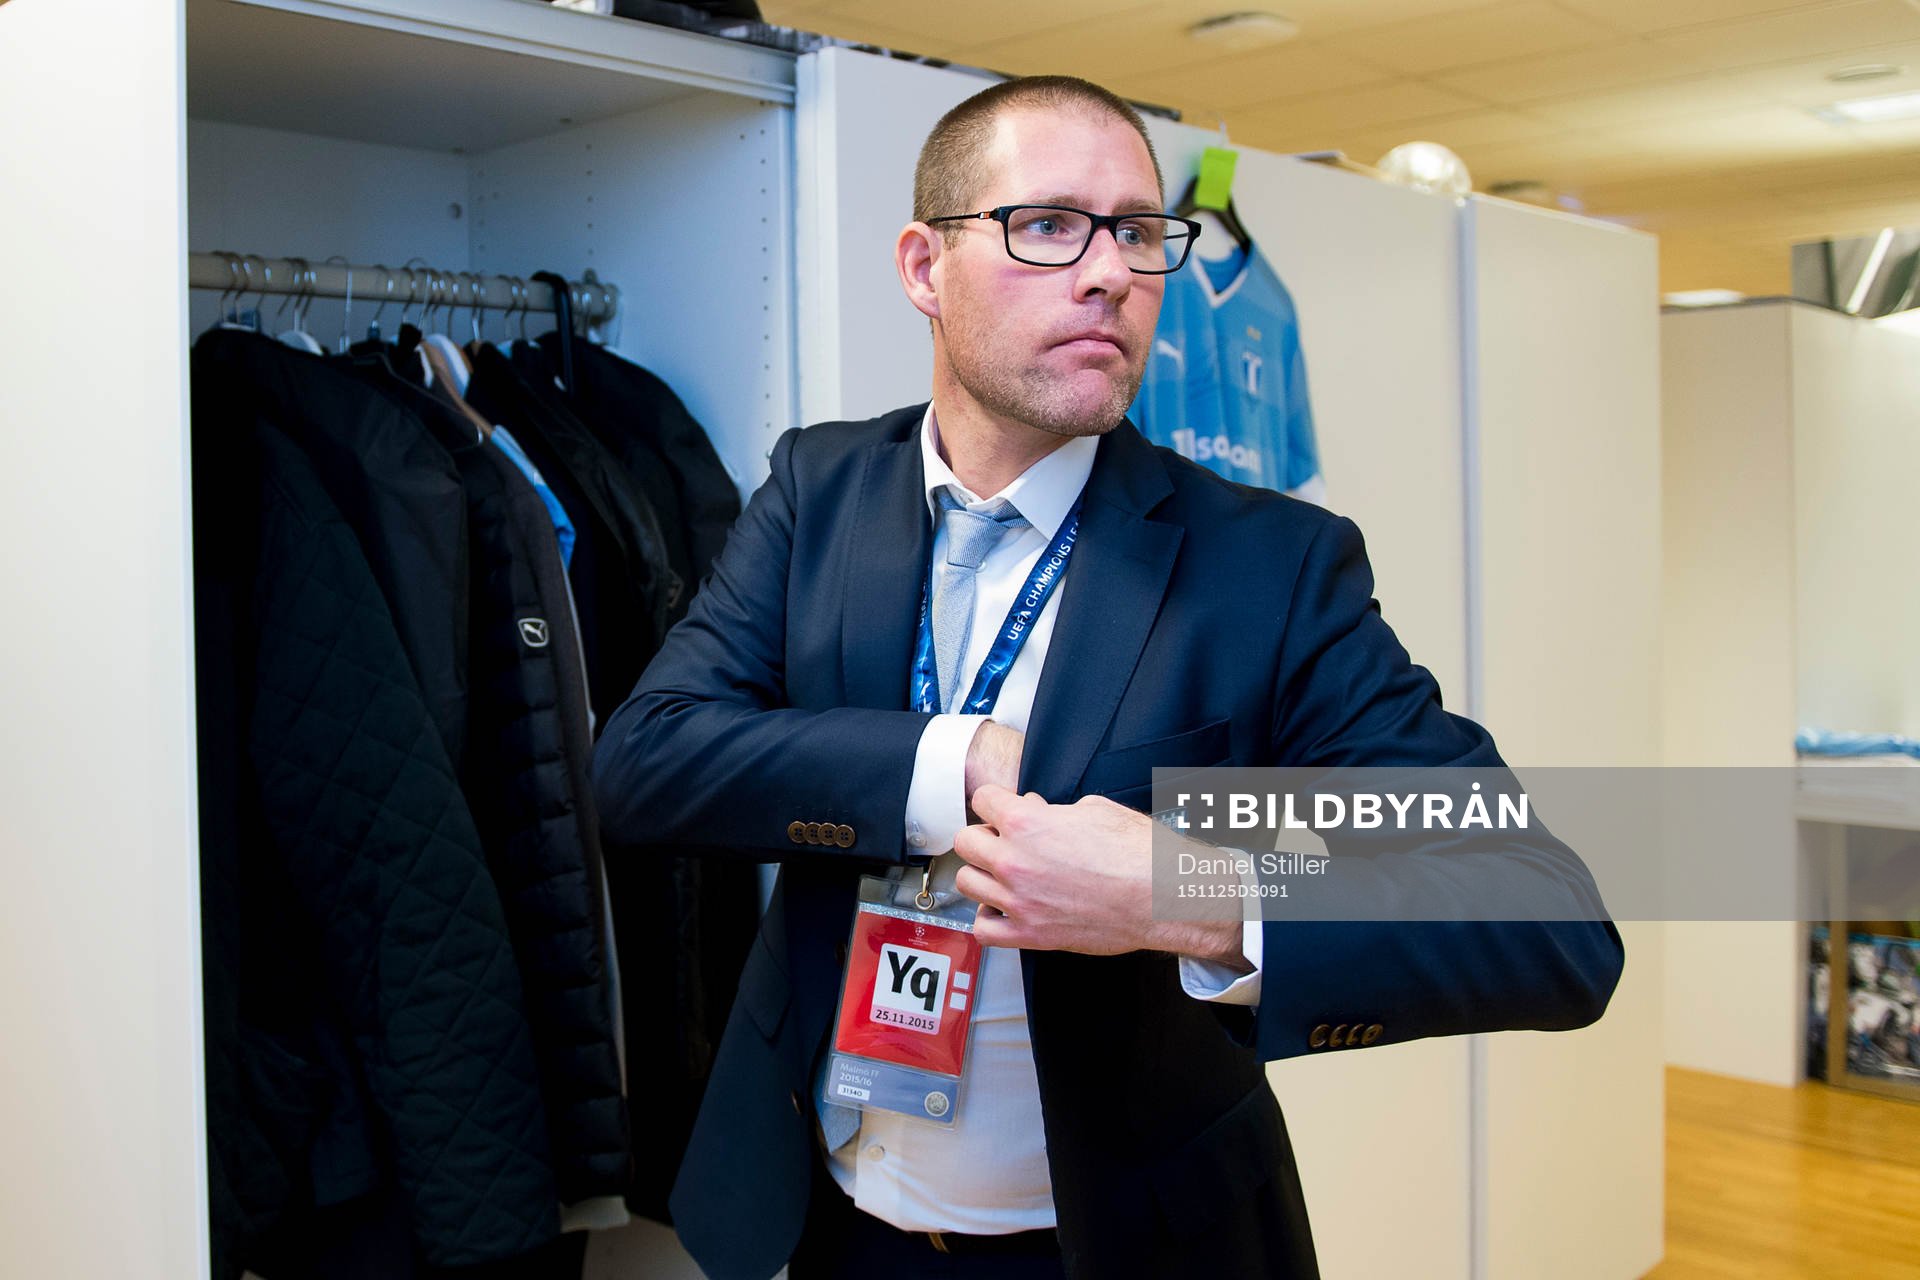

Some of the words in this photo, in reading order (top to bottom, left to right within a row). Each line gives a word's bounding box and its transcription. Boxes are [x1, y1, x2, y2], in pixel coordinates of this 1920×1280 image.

[1007, 609, 1032, 641] UEFA
[1025, 543, 1071, 608] CHAMPIONS
[886, 951, 940, 1012] Yq
[875, 1009, 935, 1031] 25.11.2015
[840, 1072, 872, 1087] 2015/16
